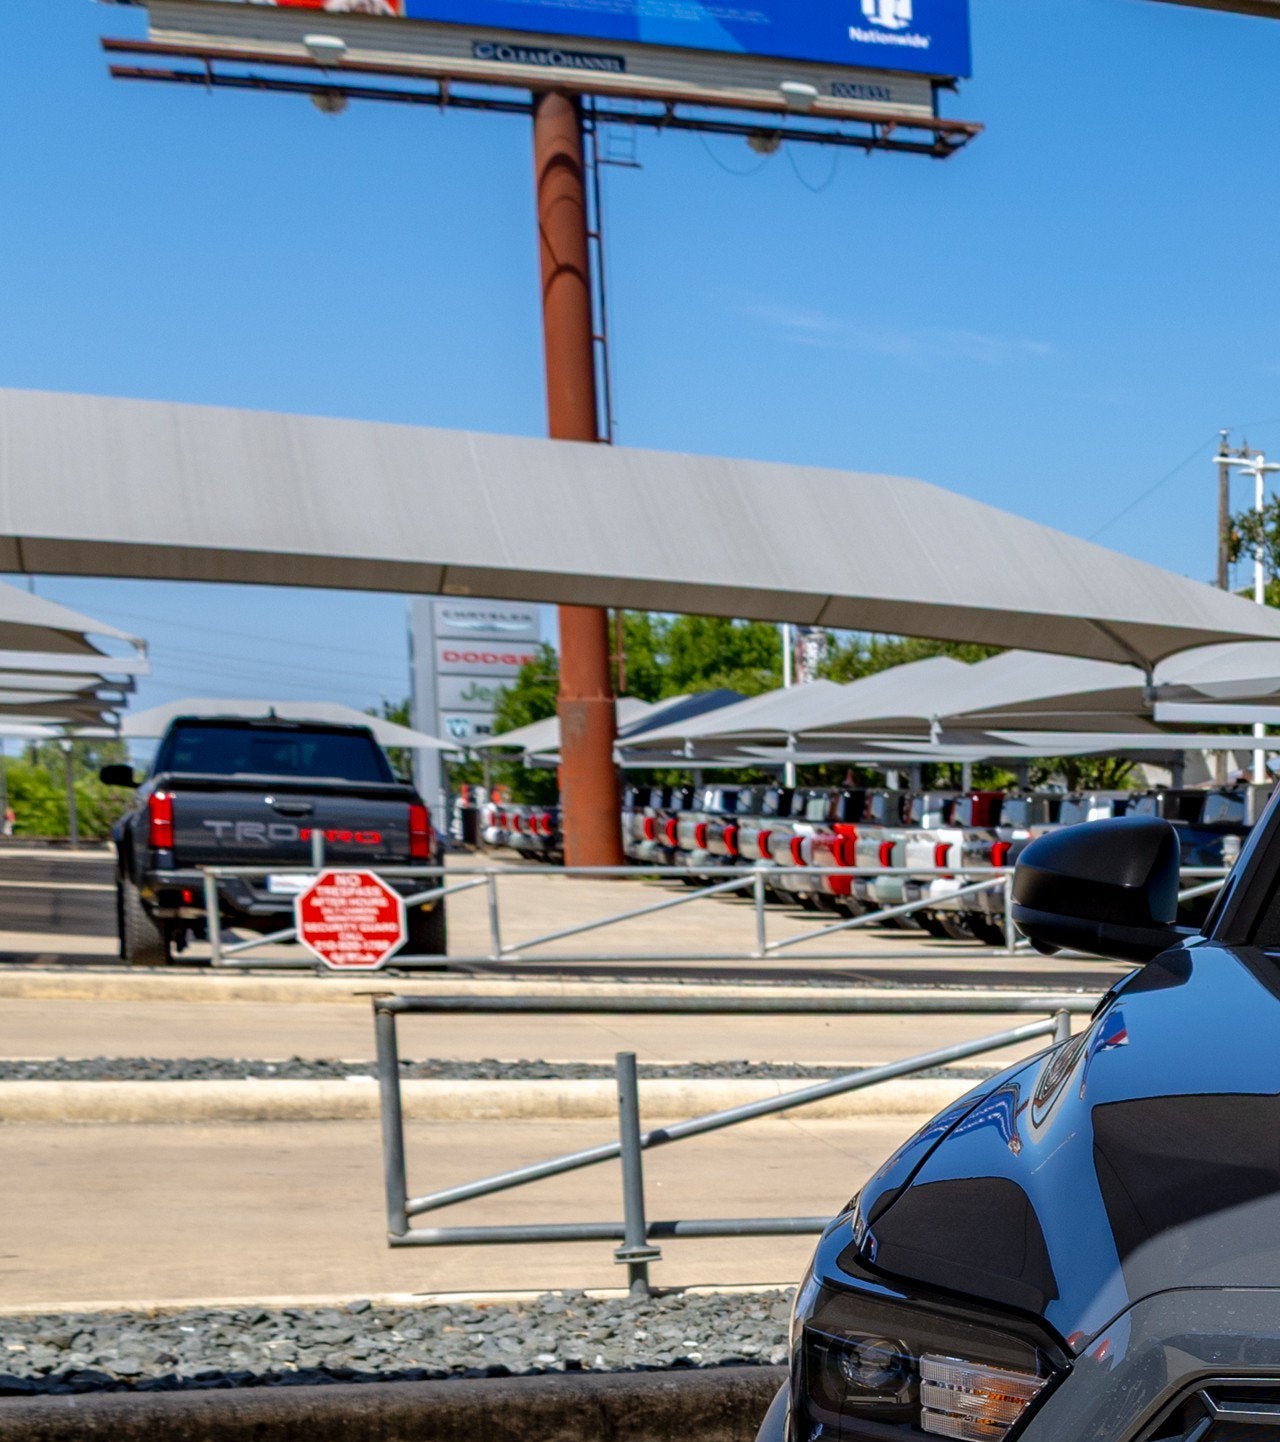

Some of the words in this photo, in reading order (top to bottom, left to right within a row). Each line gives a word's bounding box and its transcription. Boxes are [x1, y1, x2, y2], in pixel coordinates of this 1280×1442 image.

[849, 26, 929, 48] Nationwide
[203, 820, 298, 843] TRD
[335, 875, 361, 886] NO
[316, 886, 382, 897] TRESPASS
[311, 897, 346, 907] AFTER
[348, 897, 388, 907] HOURS
[304, 923, 358, 932] SECURITY
[358, 923, 398, 932] GUARD
[338, 933, 364, 941] CALL
